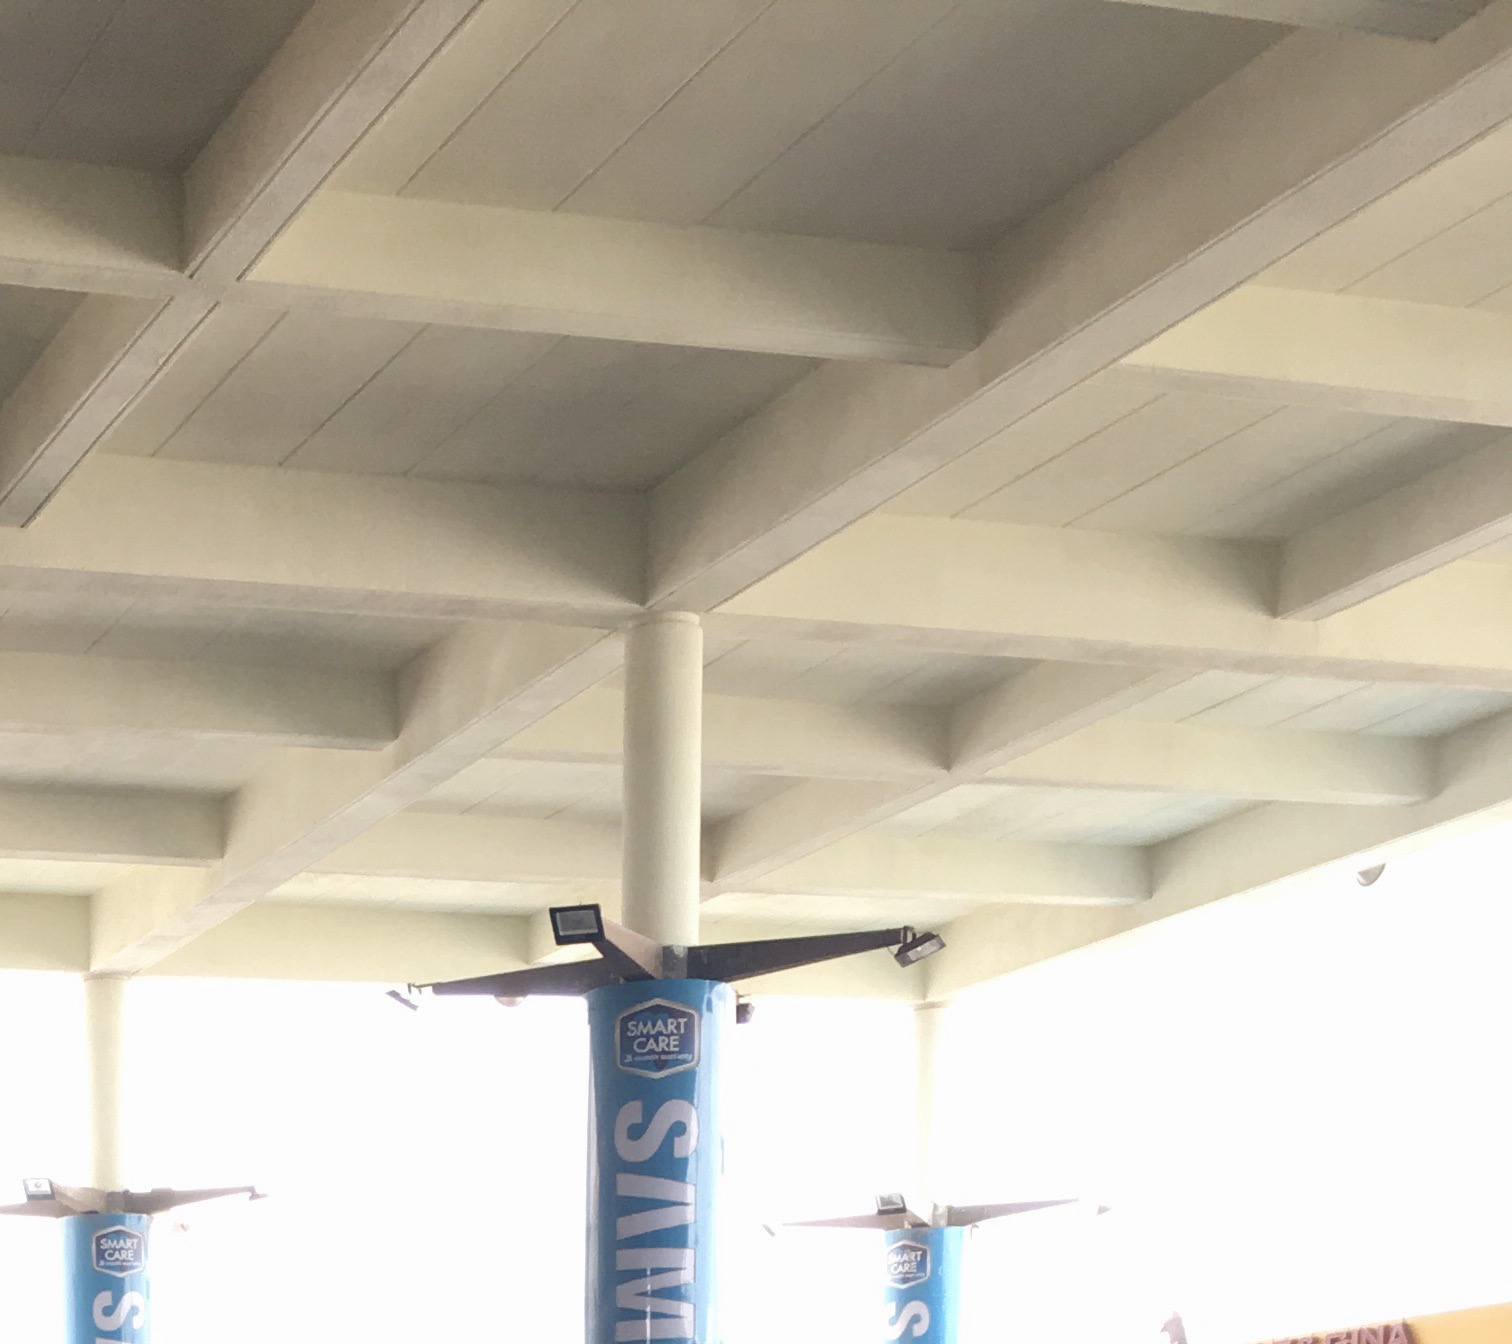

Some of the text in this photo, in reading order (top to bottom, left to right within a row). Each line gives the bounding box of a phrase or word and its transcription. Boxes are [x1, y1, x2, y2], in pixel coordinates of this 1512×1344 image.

[627, 1017, 688, 1037] SMART
[633, 1036, 680, 1053] CARE
[100, 1238, 138, 1250] SMART
[104, 1249, 135, 1261] CARE
